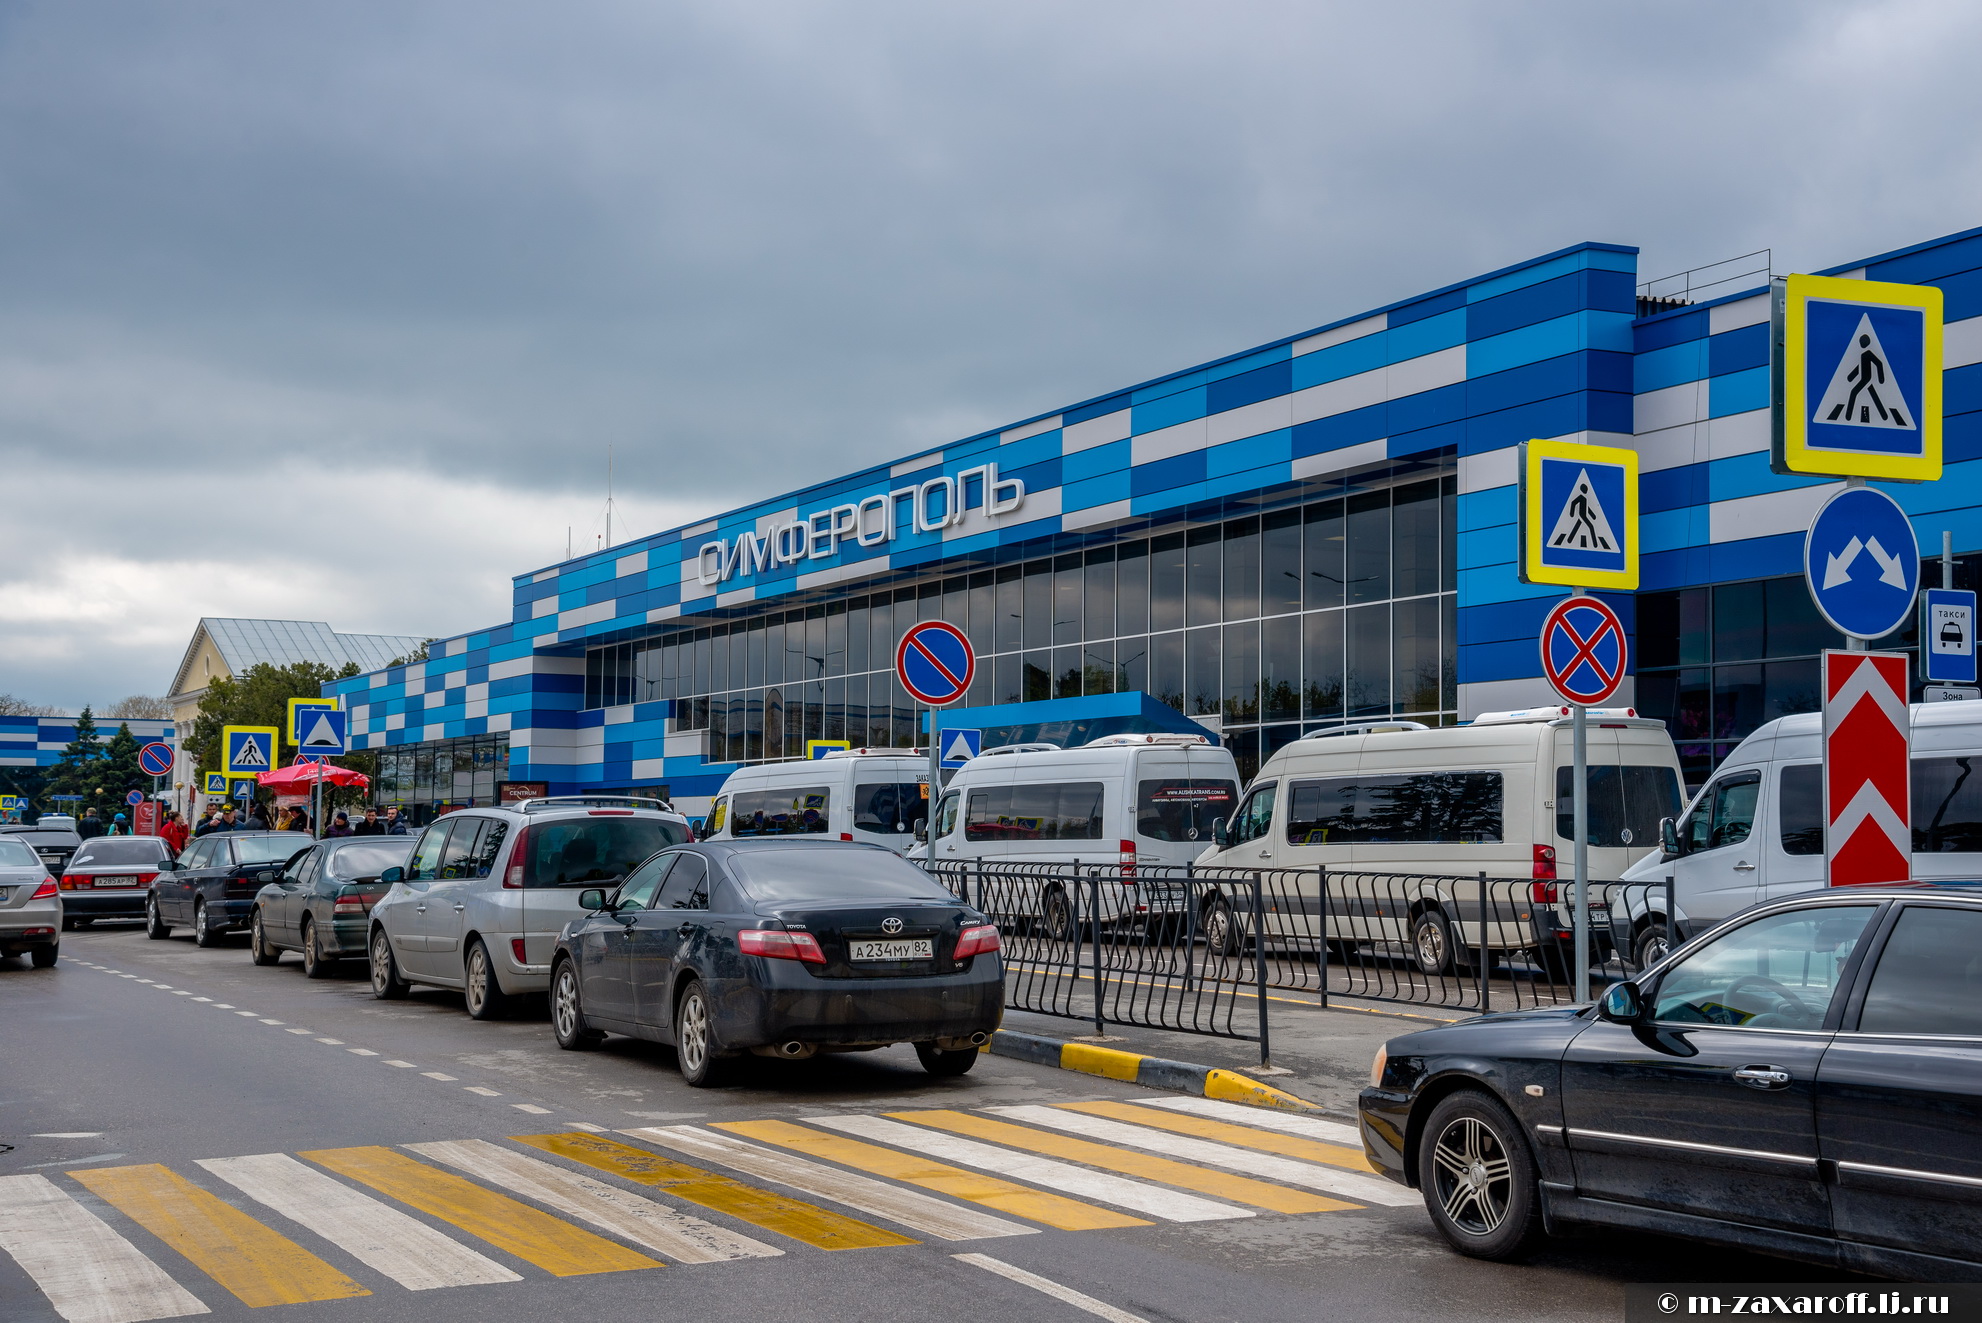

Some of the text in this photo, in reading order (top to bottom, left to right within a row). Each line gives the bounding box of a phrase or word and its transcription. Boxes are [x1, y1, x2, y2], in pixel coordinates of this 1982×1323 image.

[699, 462, 1026, 586] СИМФЕРОПОЛЬ
[1938, 610, 1966, 619] такси
[1942, 691, 1963, 700] Зона
[856, 941, 928, 958] А234МУ 82
